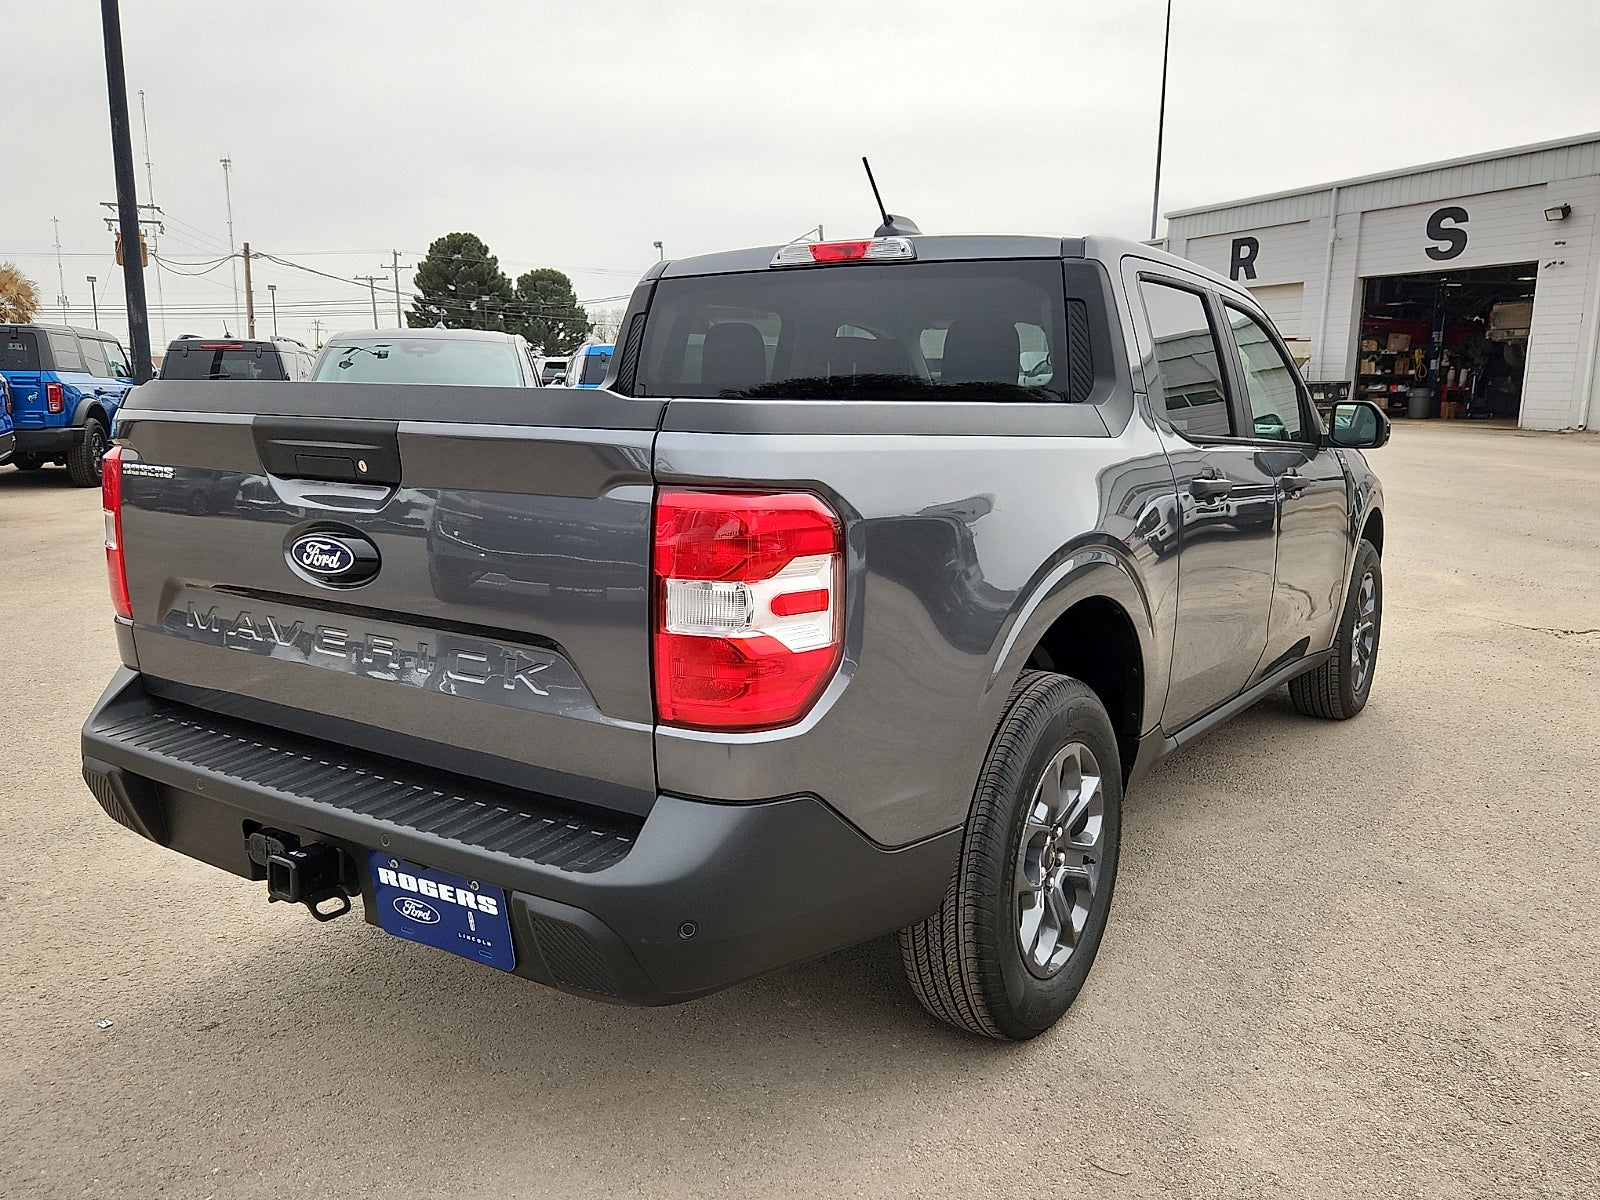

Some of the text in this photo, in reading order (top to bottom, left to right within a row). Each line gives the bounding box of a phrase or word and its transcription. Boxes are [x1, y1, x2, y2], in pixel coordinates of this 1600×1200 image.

[1424, 206, 1469, 261] S
[1230, 236, 1259, 281] R
[301, 540, 343, 570] Ford
[186, 601, 551, 696] MAVERICK
[377, 867, 499, 916] ROGERS
[400, 899, 434, 922] Ford
[457, 932, 493, 947] LINCOLN
